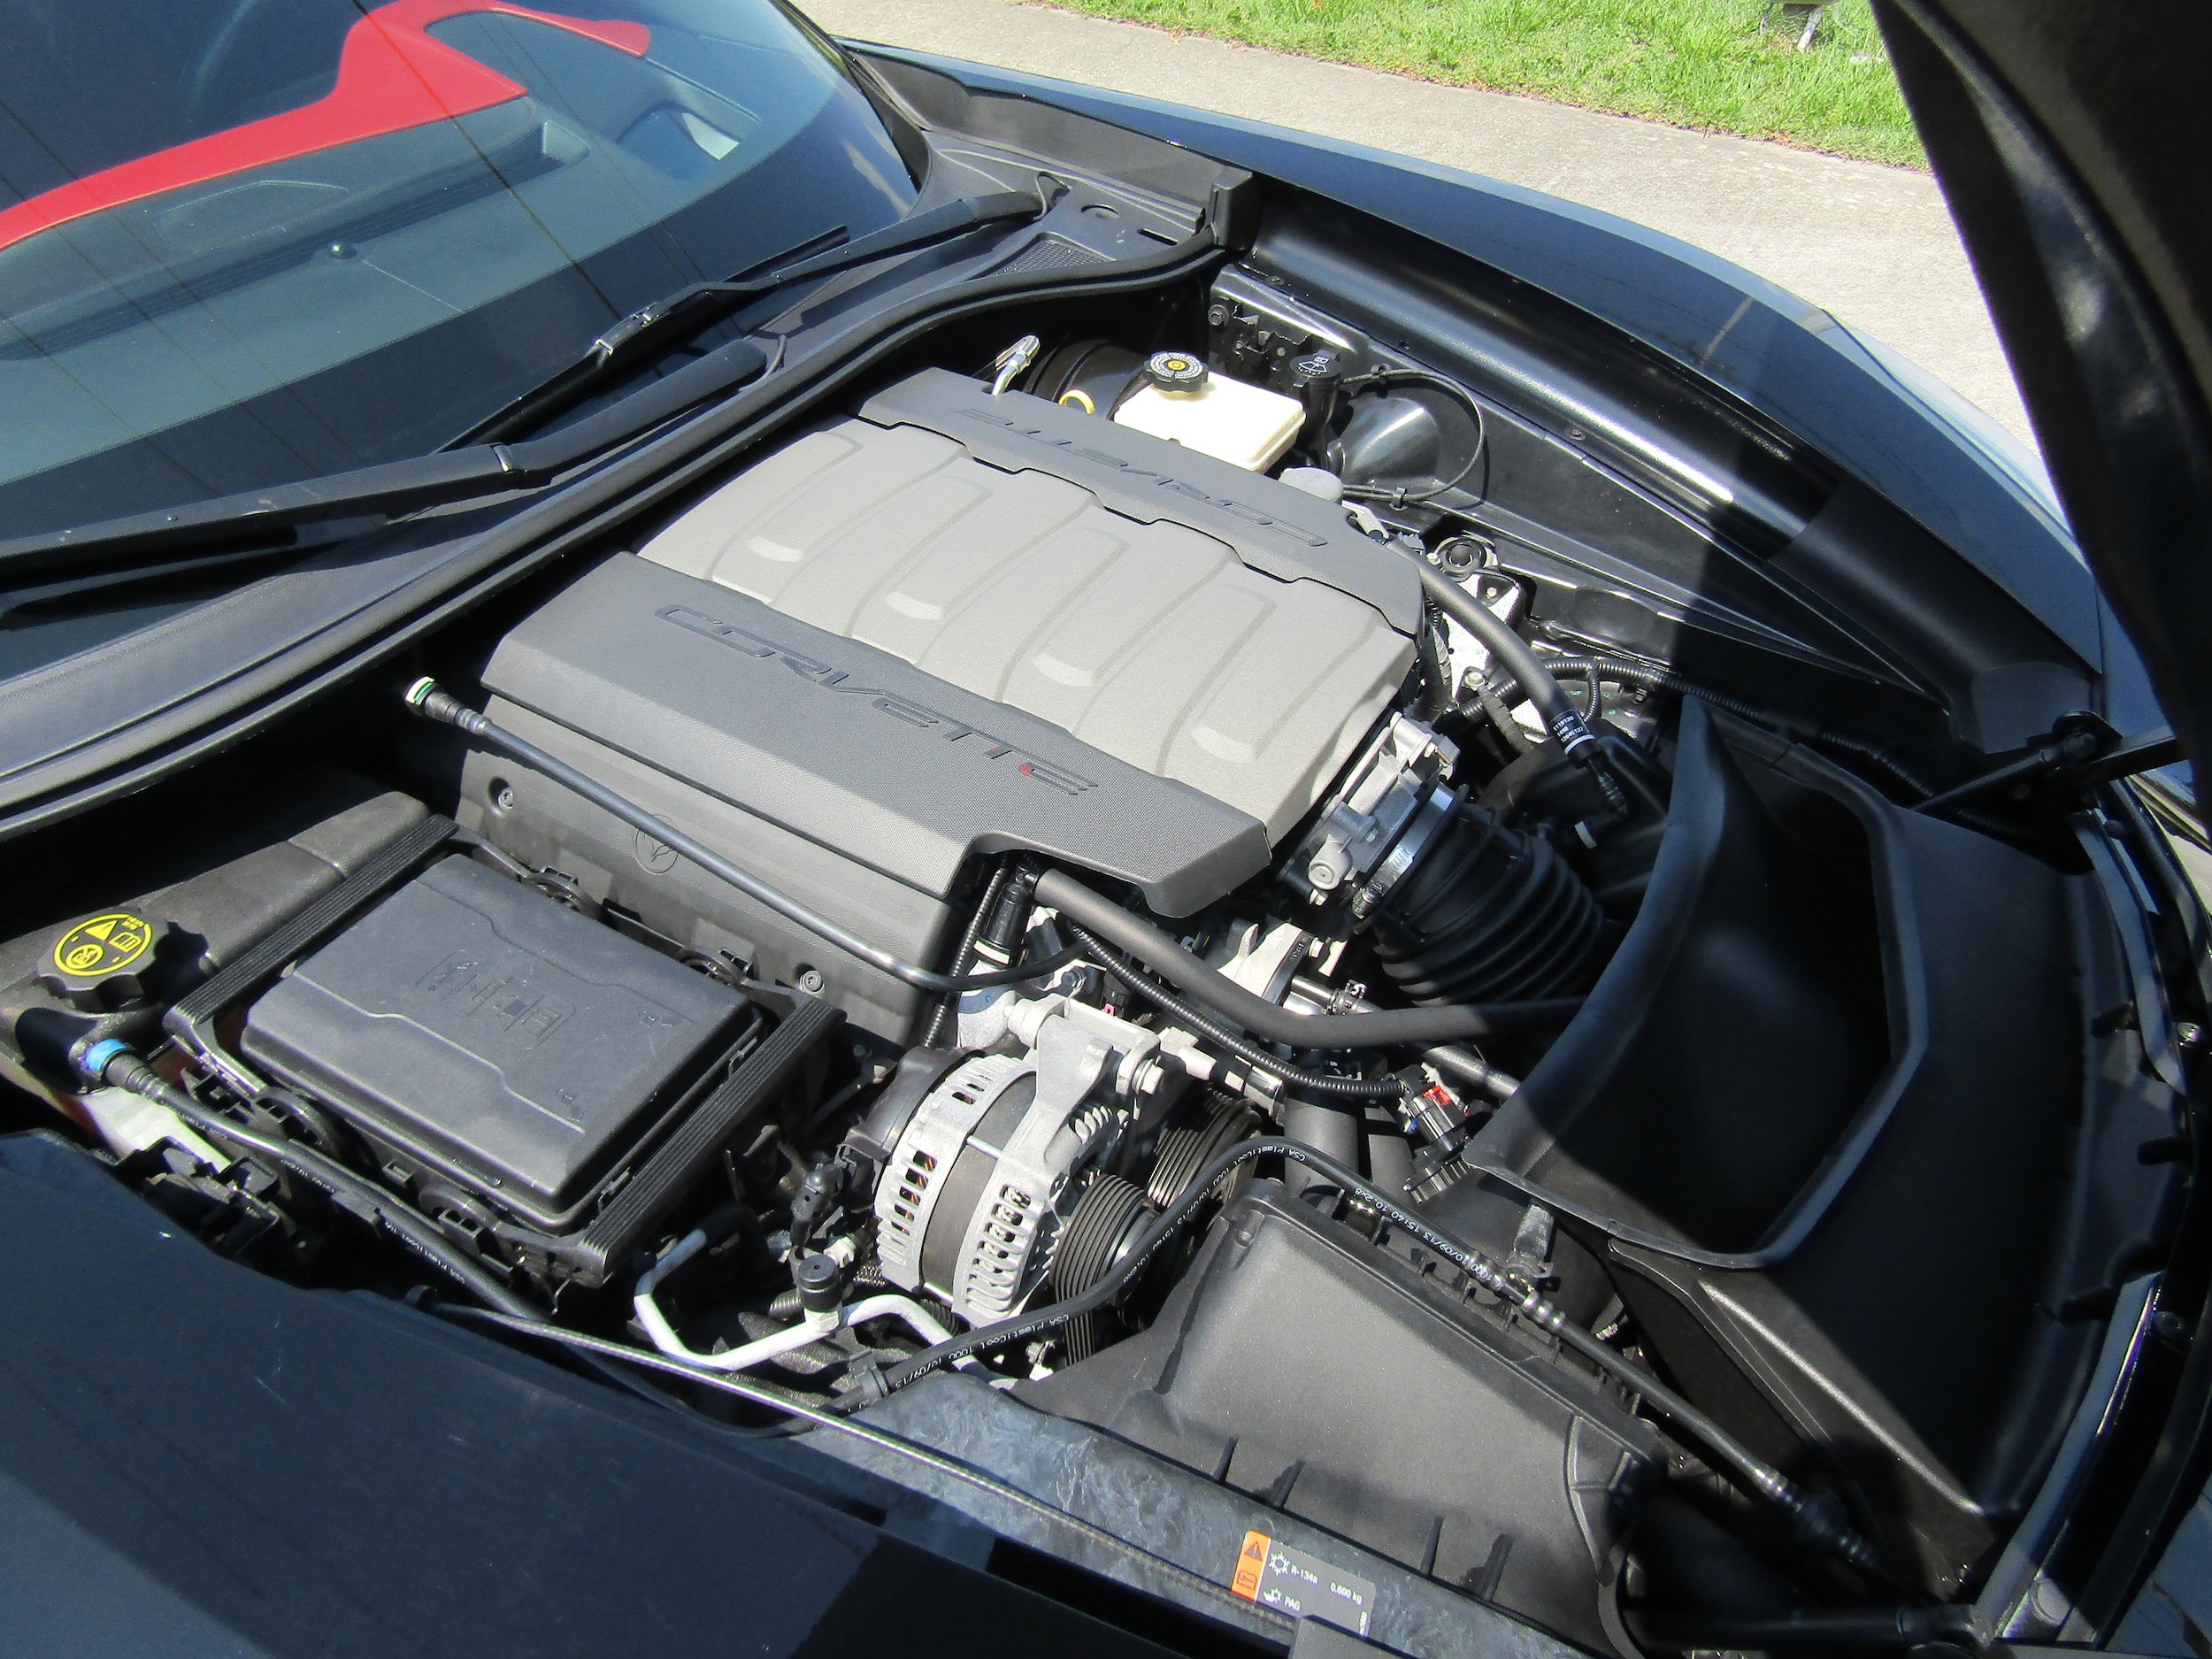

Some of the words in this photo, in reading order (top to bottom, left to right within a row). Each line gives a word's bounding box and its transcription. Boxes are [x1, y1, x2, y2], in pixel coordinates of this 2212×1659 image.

[655, 603, 1099, 795] CORVETTE
[1288, 1148, 1306, 1162] CSA
[1391, 1210, 1419, 1233] 15:40
[1423, 1231, 1468, 1265] 10/09/13
[1049, 1314, 1070, 1325] CSA
[1291, 1564, 1318, 1585] R-134a
[1352, 1591, 1363, 1605] kg
[1284, 1595, 1301, 1611] PAG
